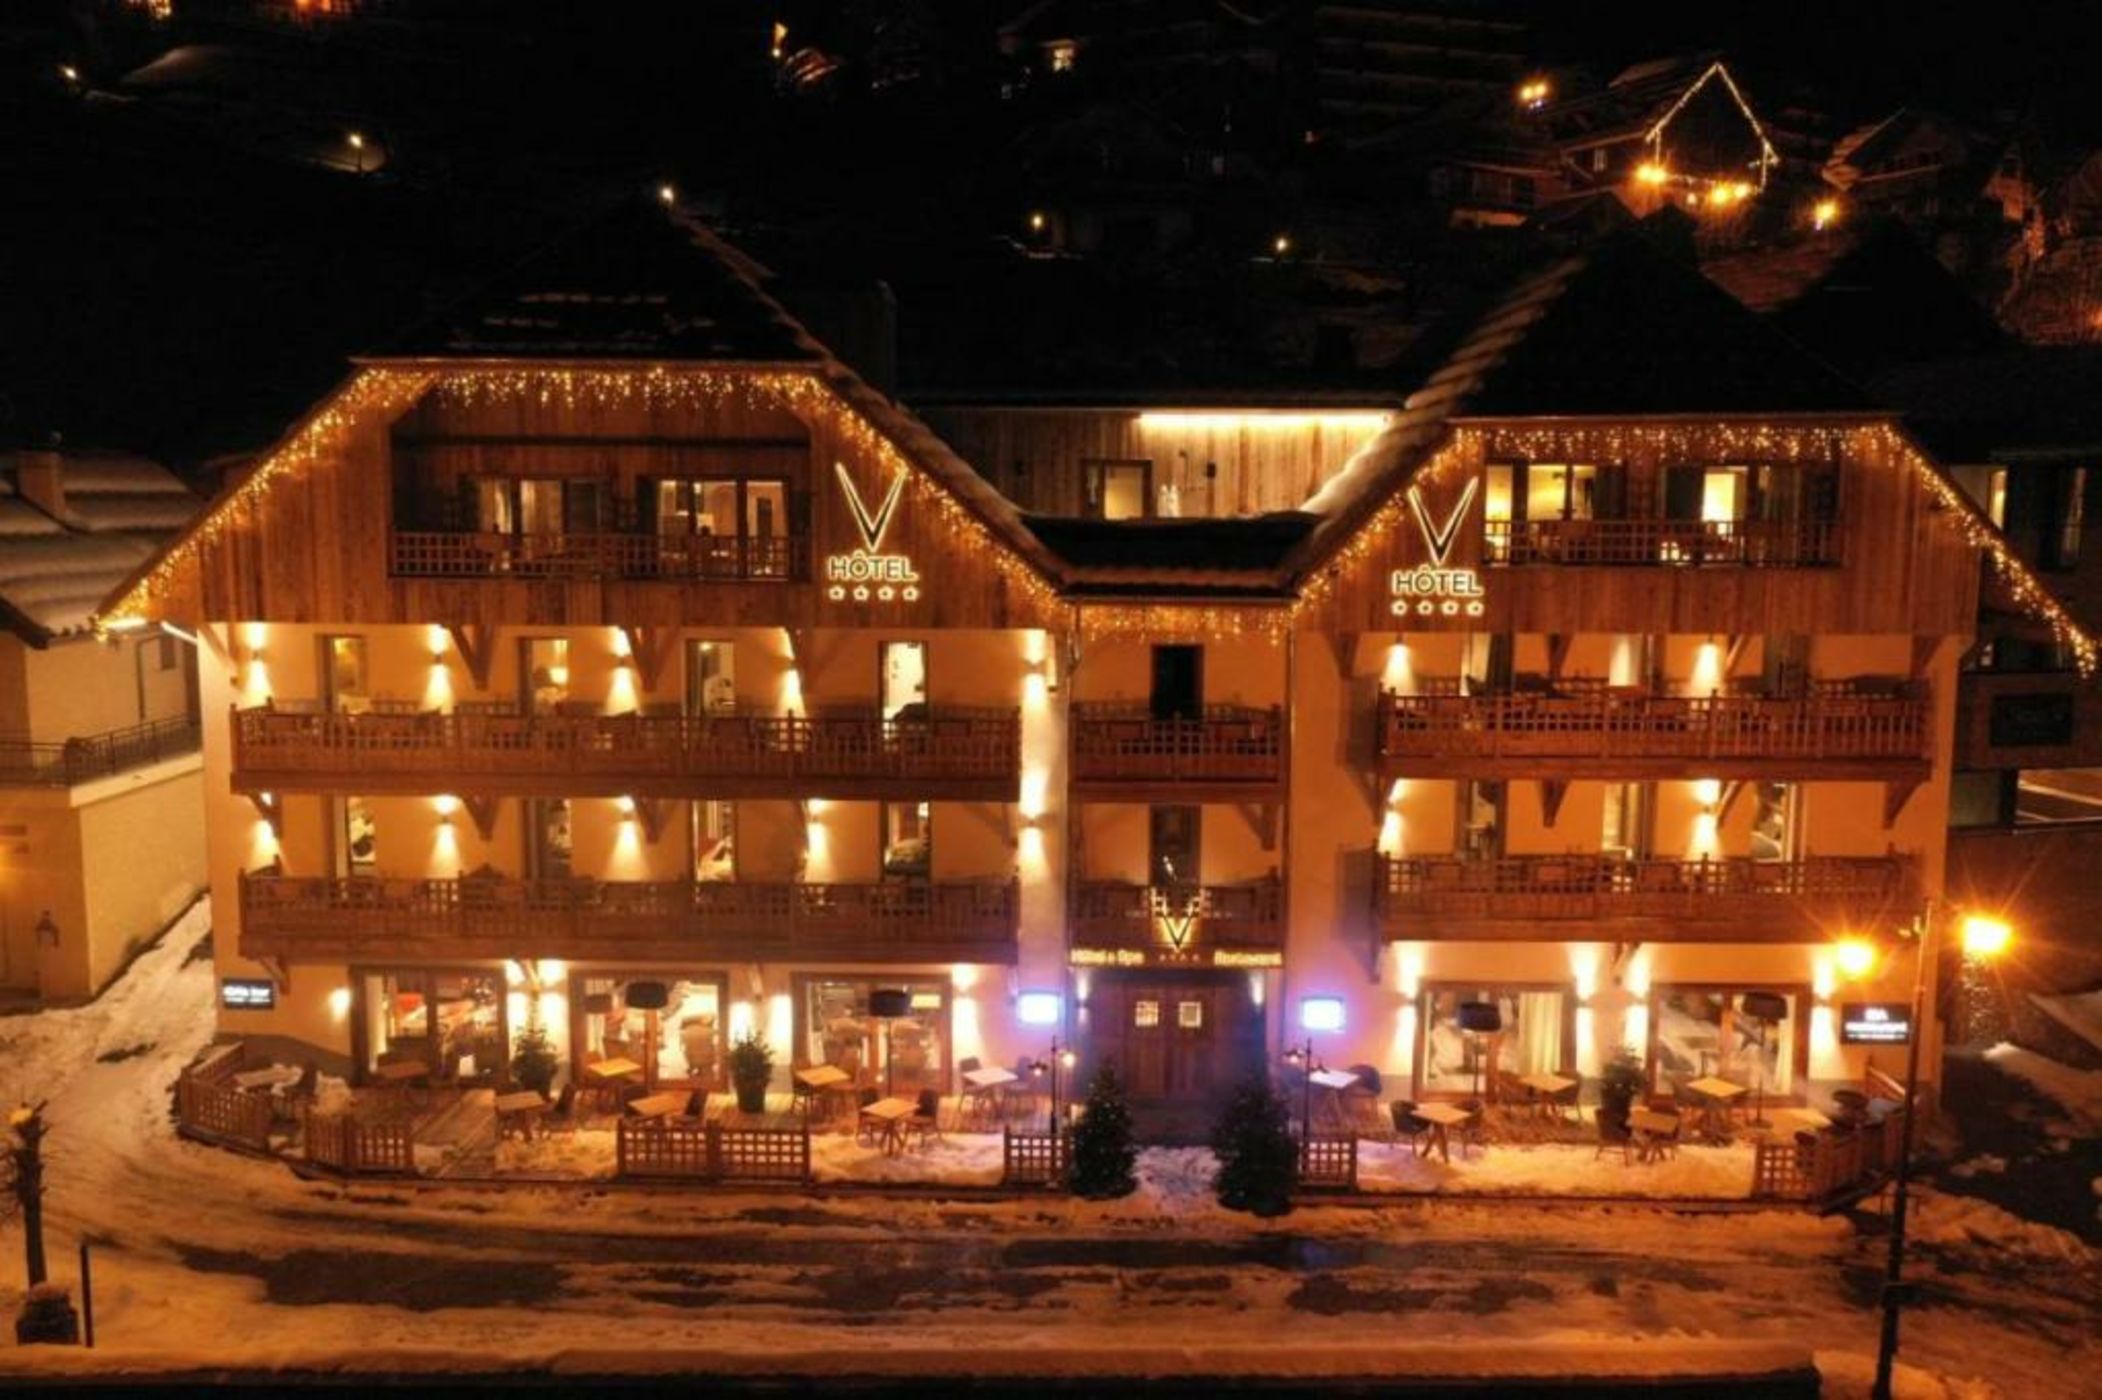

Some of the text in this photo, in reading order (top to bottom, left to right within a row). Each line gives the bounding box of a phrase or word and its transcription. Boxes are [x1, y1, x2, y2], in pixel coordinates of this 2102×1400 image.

[835, 462, 907, 553] V
[1408, 476, 1479, 567] V
[828, 549, 919, 582] HÔTEL
[1392, 564, 1484, 596] HÔTEL
